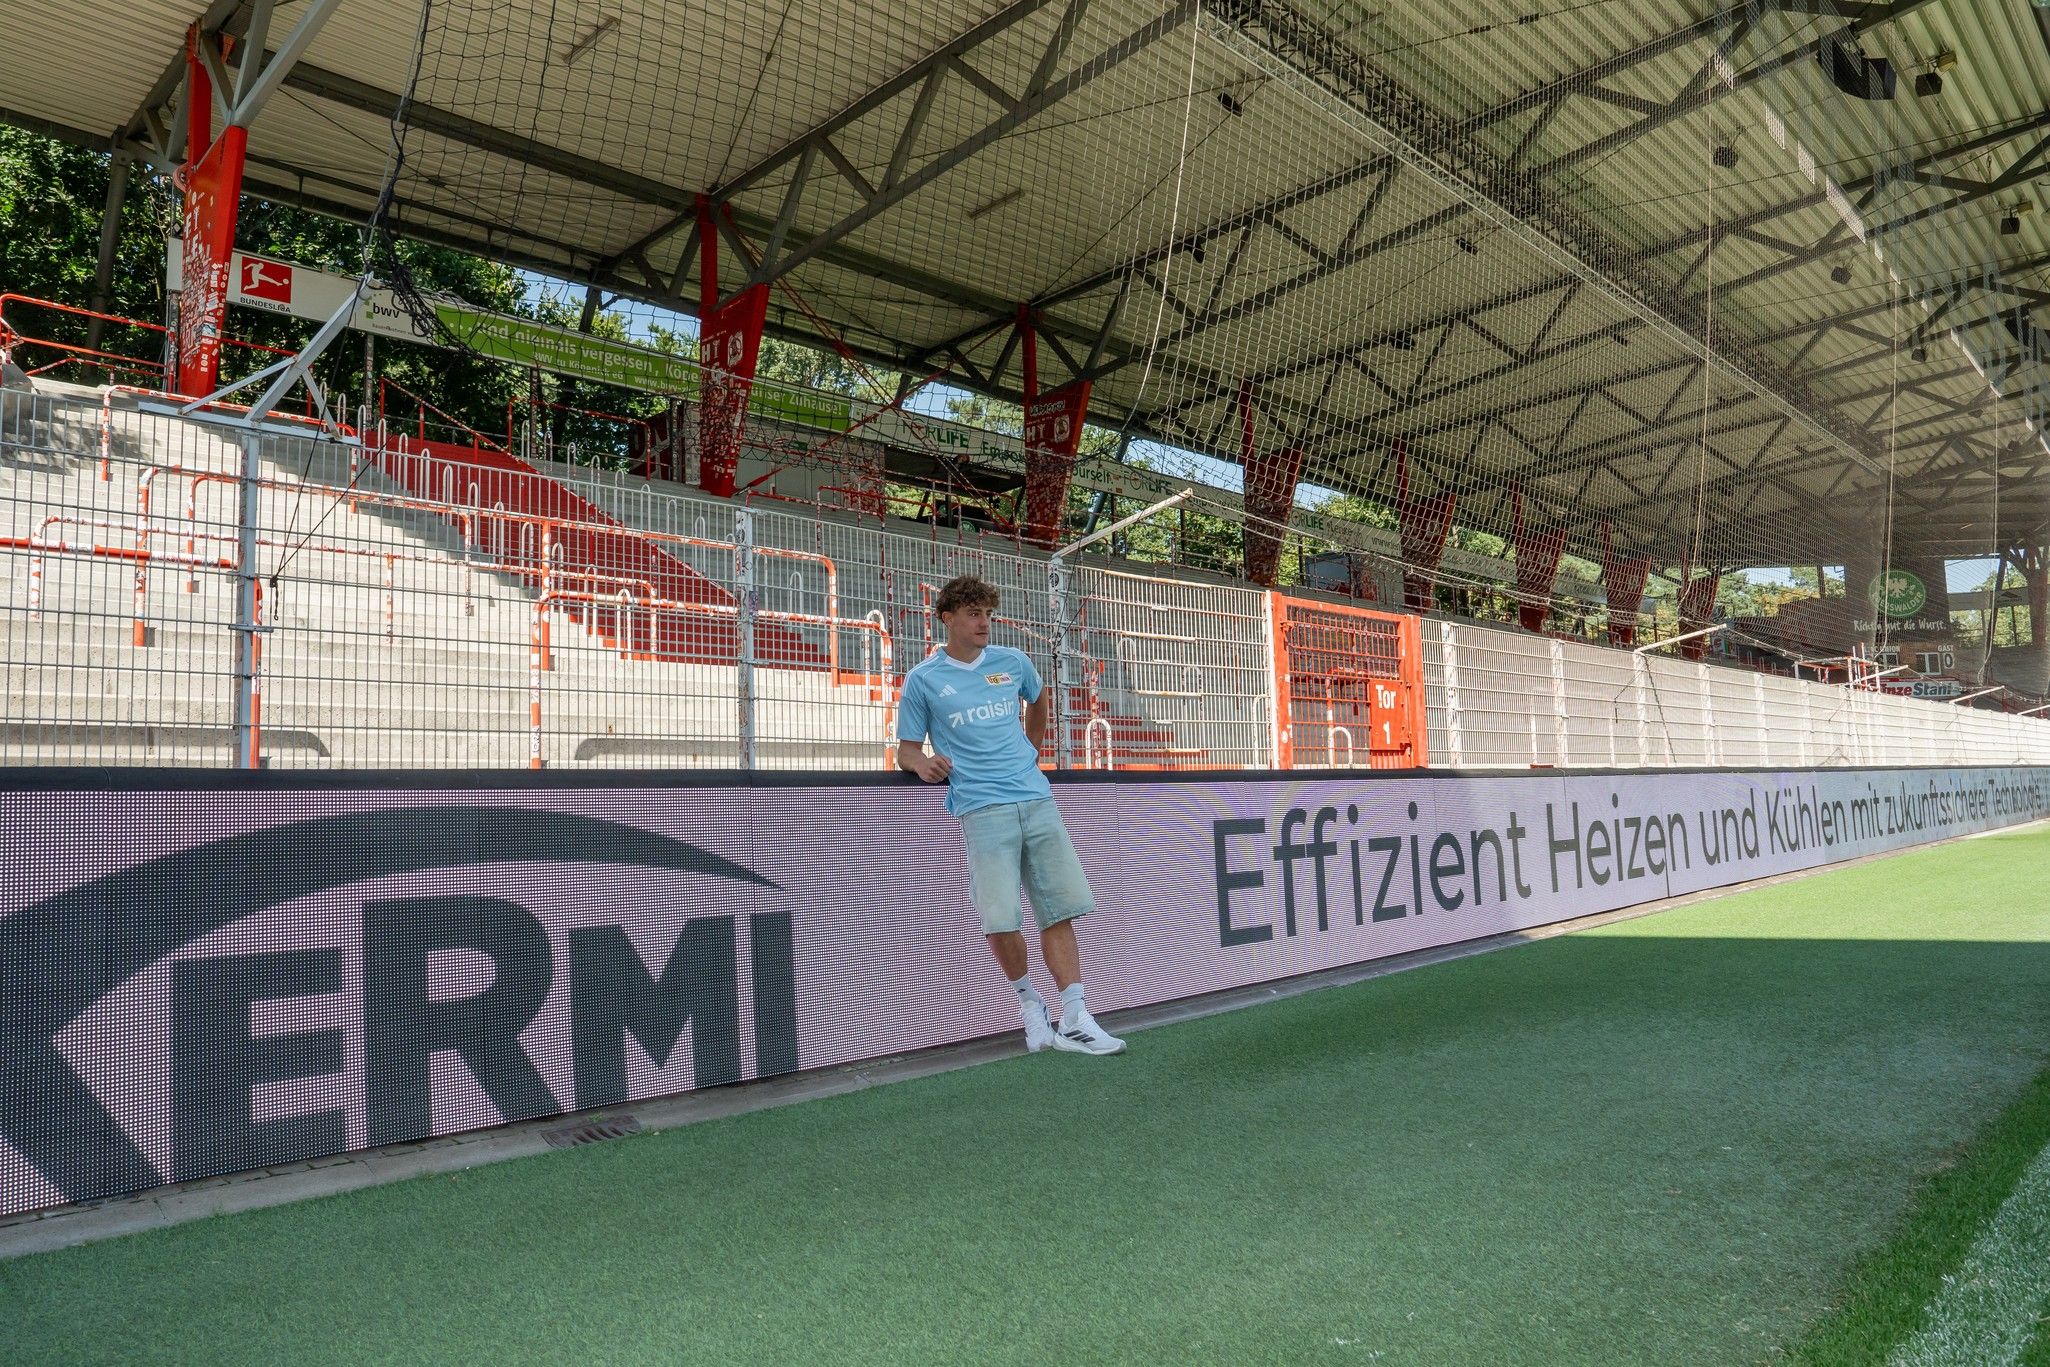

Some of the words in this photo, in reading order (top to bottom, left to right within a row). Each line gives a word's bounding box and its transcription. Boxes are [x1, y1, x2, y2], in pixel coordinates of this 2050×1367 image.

[240, 297, 291, 313] BUNDESLIGA
[373, 303, 400, 318] bwv
[1937, 644, 1954, 652] GAST
[1375, 684, 1397, 709] Tor
[967, 698, 1014, 724] raisin
[1383, 721, 1391, 745] 1
[1212, 801, 1531, 948] Effizient
[1546, 793, 1690, 893] Heizen
[1702, 788, 1760, 867] und
[1767, 785, 1848, 853] Kühlen
[1851, 782, 1883, 841] mit
[1885, 778, 1989, 834] zukunftssicherer
